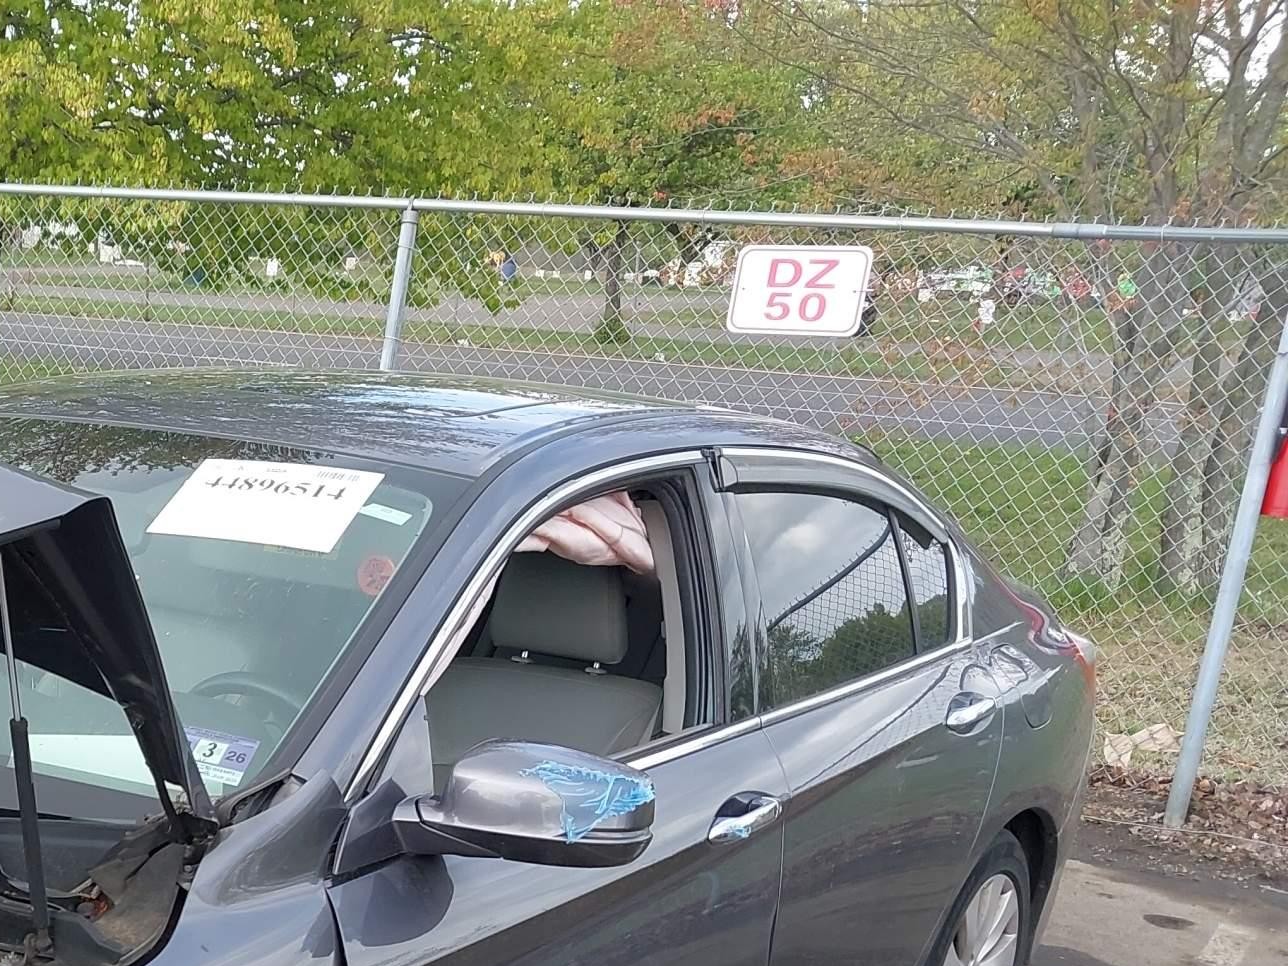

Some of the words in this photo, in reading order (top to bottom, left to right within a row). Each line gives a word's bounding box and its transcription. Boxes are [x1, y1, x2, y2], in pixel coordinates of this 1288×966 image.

[766, 258, 841, 289] DZ
[764, 291, 827, 322] 50
[205, 475, 348, 501] 44896514
[202, 742, 218, 758] 3
[225, 750, 248, 764] 26
